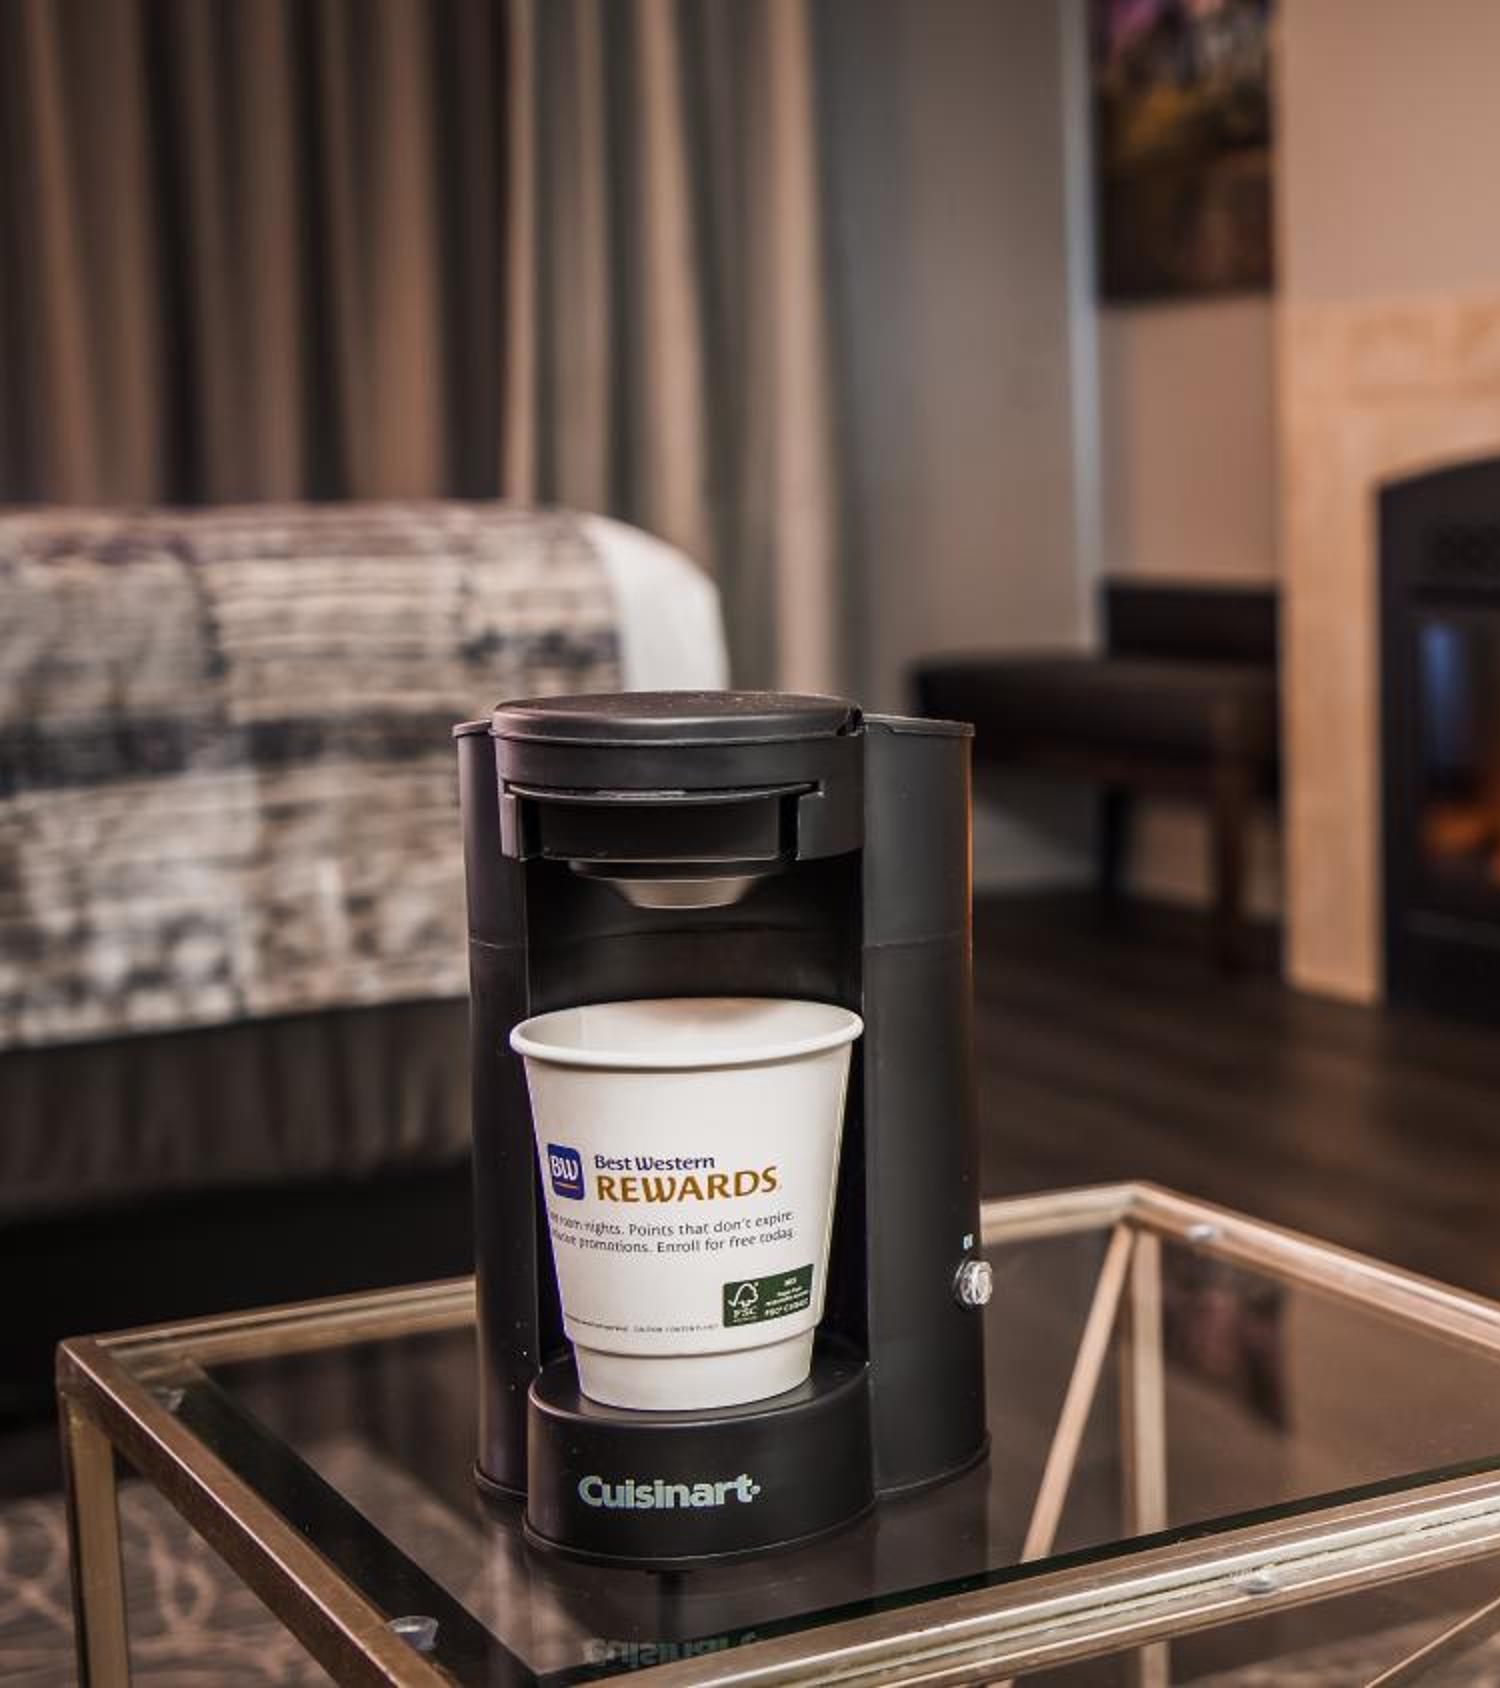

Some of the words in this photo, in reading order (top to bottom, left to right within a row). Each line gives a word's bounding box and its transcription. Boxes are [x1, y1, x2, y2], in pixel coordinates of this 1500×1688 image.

[551, 1155, 578, 1181] BW
[594, 1154, 633, 1171] Best
[636, 1154, 716, 1171] Western
[597, 1165, 778, 1203] REWARDS
[628, 1223, 675, 1238] Points
[679, 1223, 709, 1236] that
[713, 1218, 752, 1233] don't
[657, 1240, 700, 1254] Enroll
[705, 1237, 724, 1252] for
[729, 1235, 757, 1249] free
[577, 1473, 753, 1509] Cuisinart
